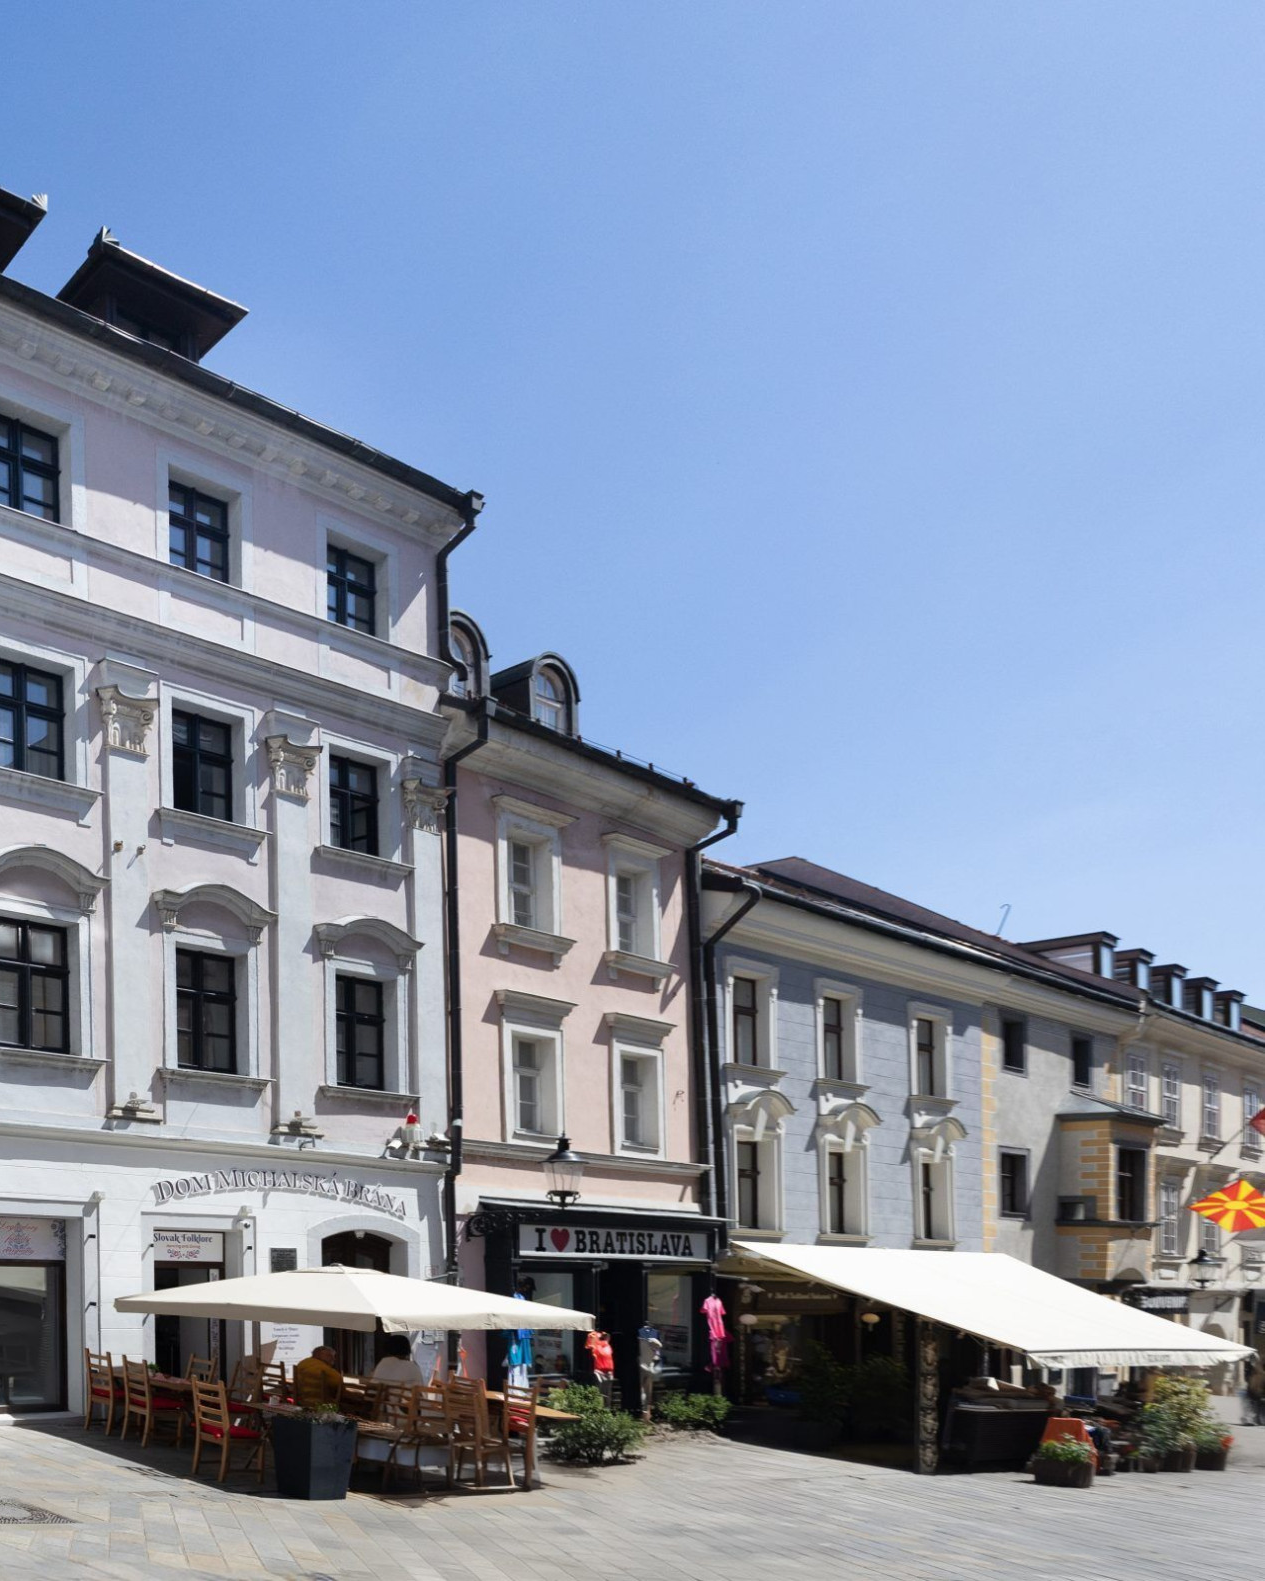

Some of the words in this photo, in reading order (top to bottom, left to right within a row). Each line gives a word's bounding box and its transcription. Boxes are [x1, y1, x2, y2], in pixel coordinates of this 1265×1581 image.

[156, 1173, 213, 1202] DOM
[215, 1168, 341, 1197] MICHALSKÁ
[343, 1178, 407, 1217] BRÁNA
[152, 1232, 180, 1244] Slovak
[535, 1228, 546, 1252] I
[574, 1229, 694, 1256] BRATISLAVA
